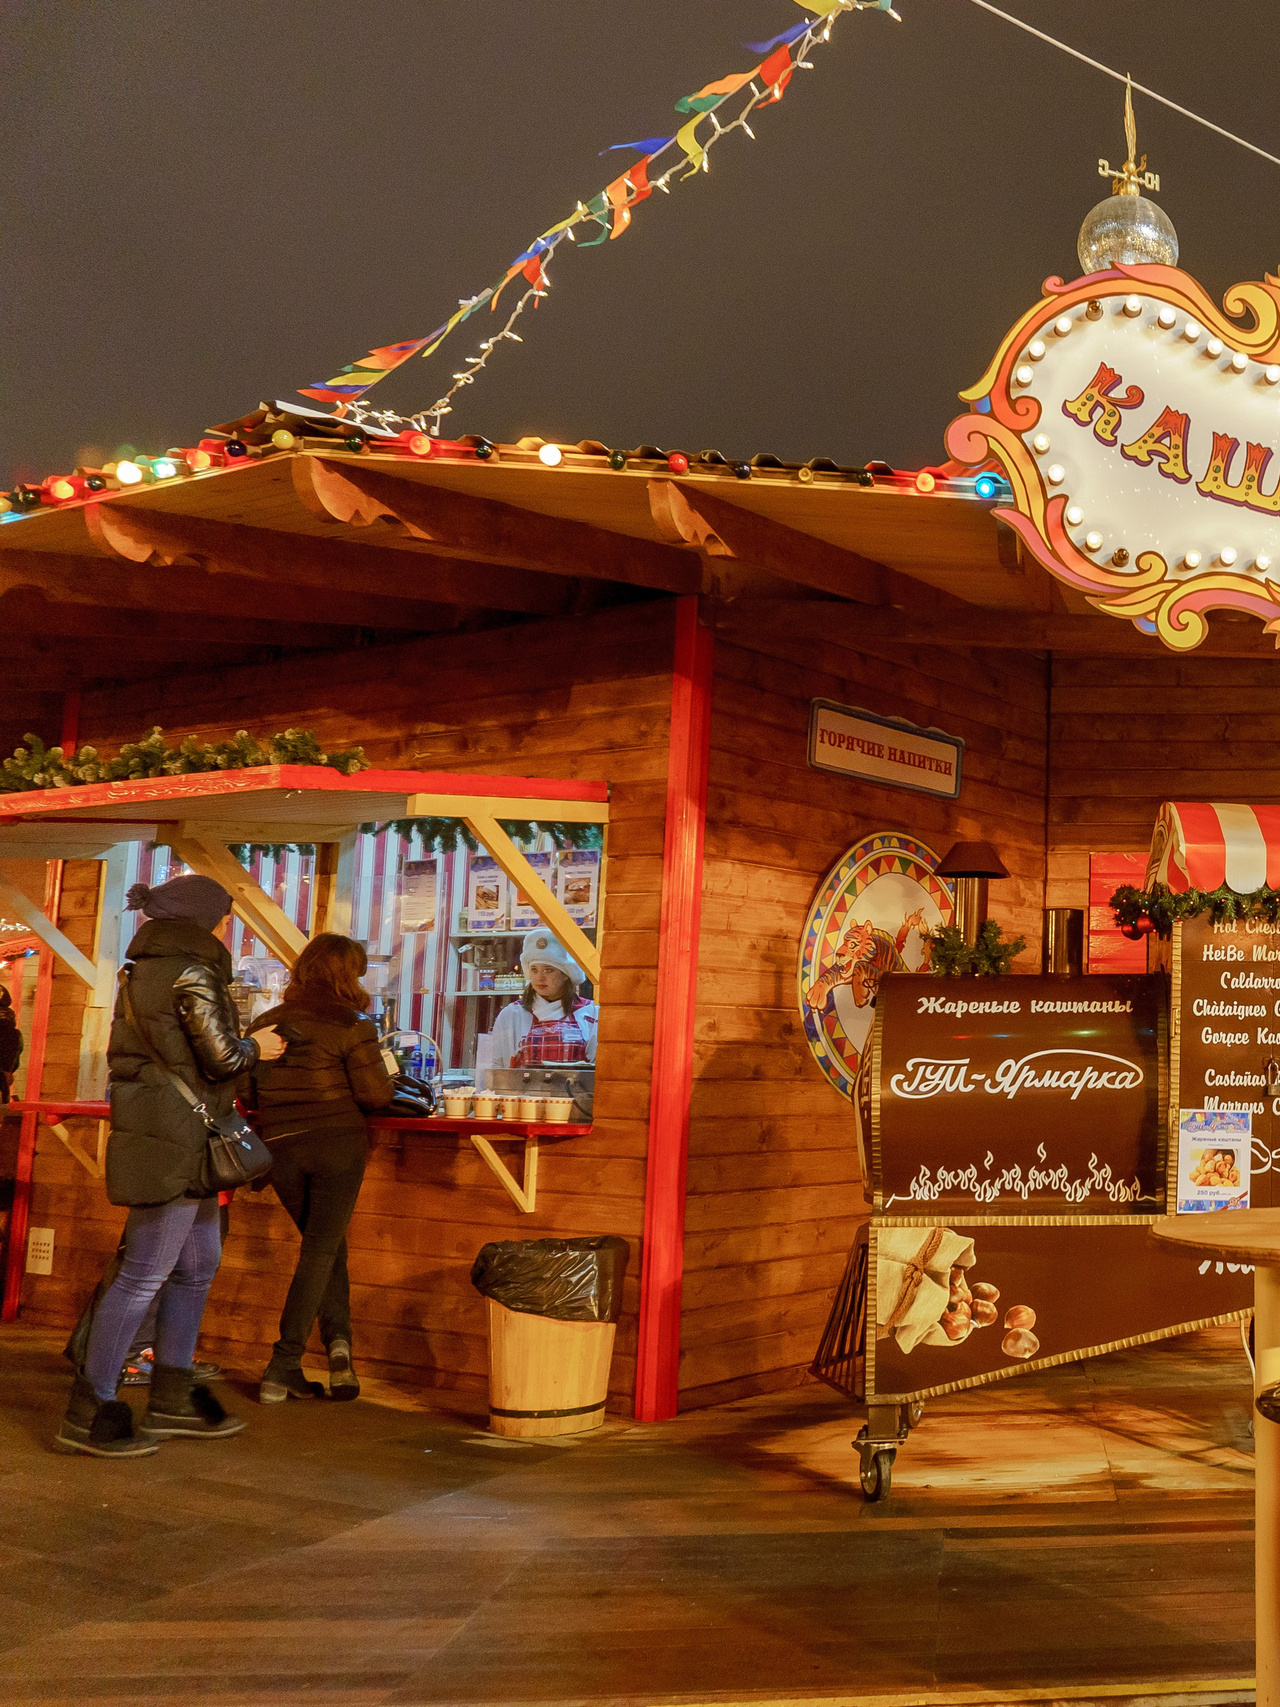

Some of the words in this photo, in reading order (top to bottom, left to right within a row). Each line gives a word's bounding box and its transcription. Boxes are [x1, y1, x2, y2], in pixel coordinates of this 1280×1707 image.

[819, 728, 885, 759] ГОРЯЧИЕ
[887, 746, 953, 776] НАПИТКИ
[1213, 919, 1238, 934] Hot
[917, 996, 1022, 1018] Жареные
[1030, 999, 1134, 1014] каштаны
[1204, 1068, 1267, 1087] Castañas
